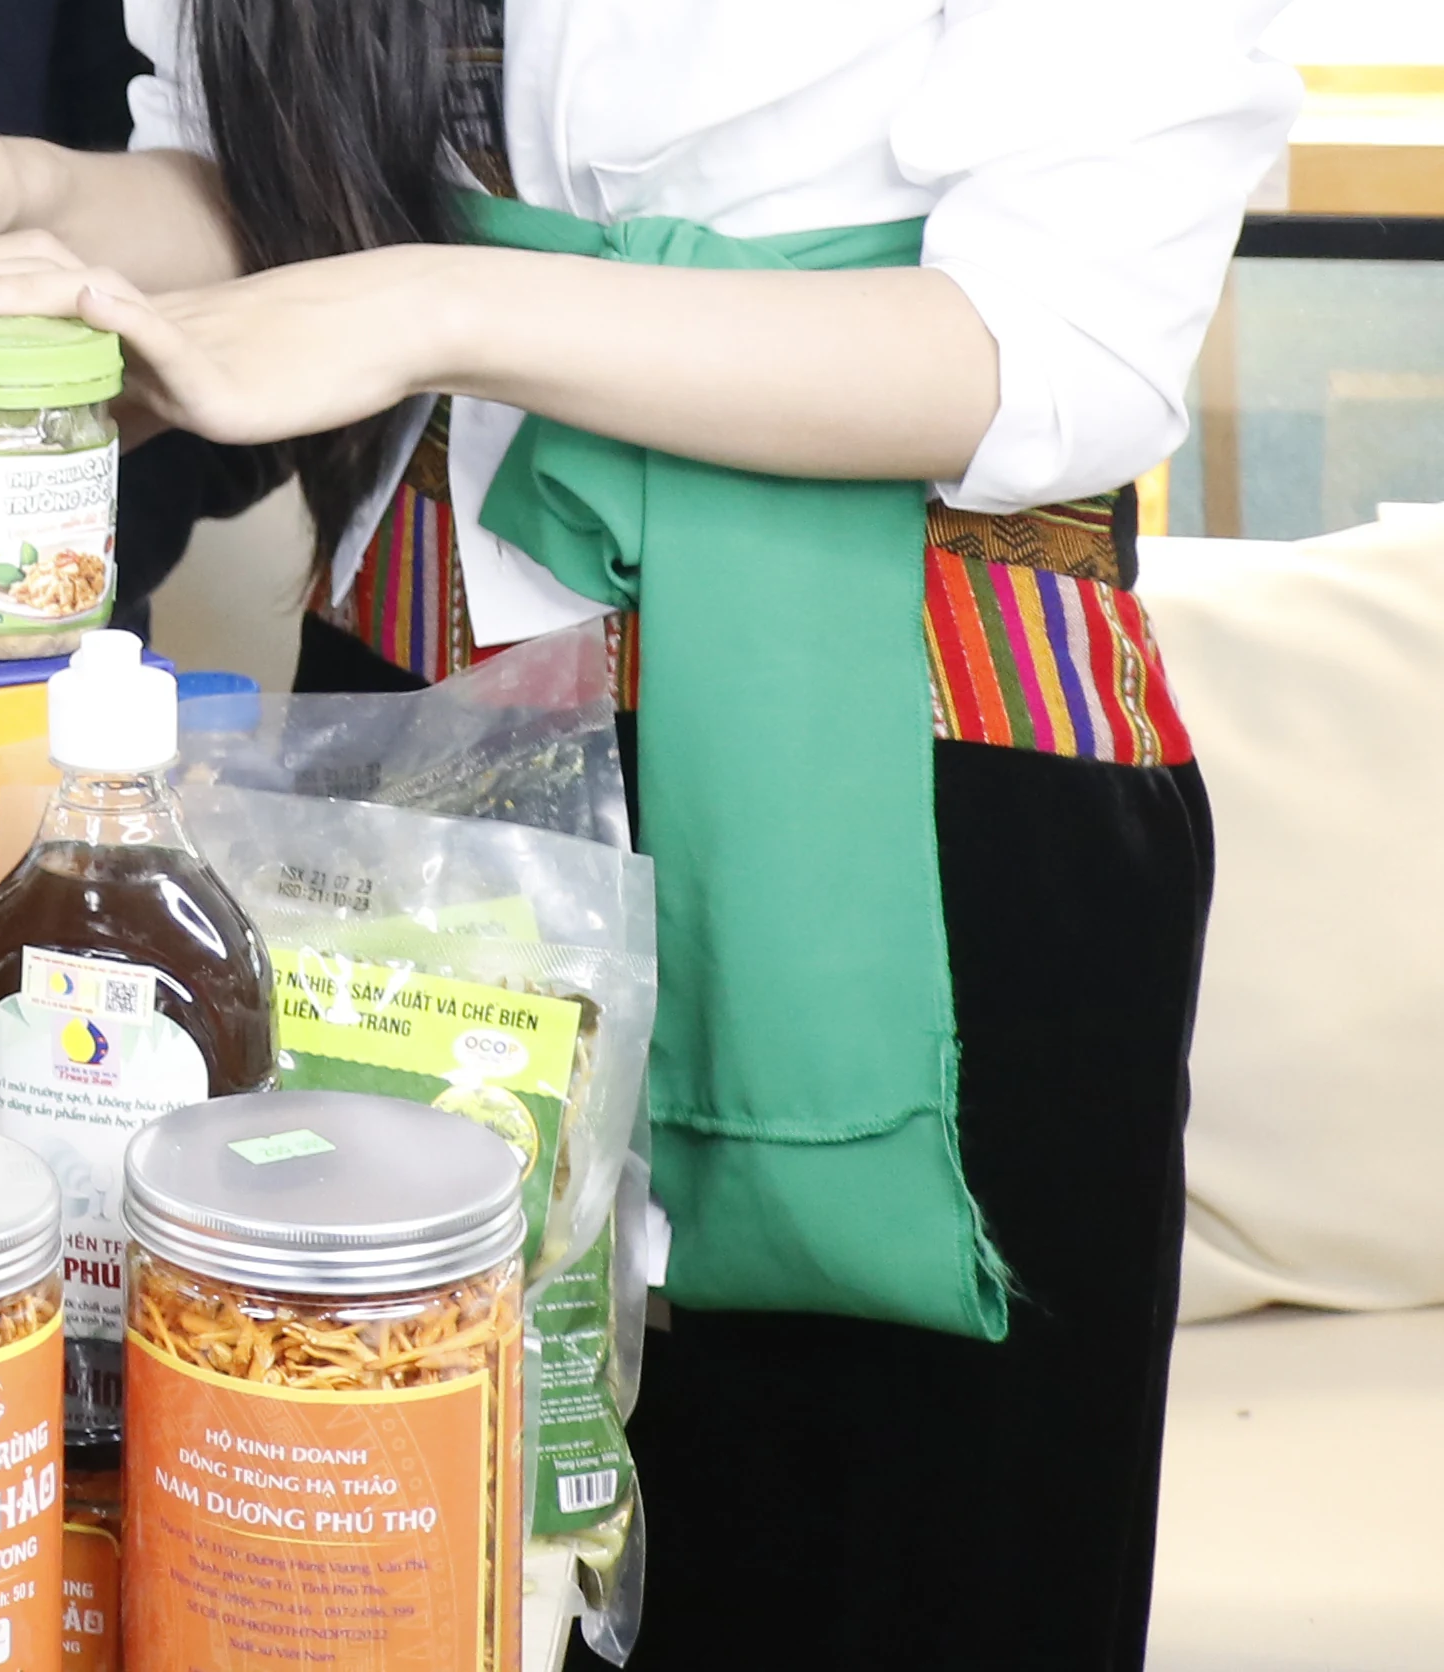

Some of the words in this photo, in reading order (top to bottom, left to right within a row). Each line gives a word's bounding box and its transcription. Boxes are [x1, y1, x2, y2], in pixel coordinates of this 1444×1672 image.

[4, 490, 79, 515] TRƯỜNG
[358, 1011, 413, 1038] TRANG
[389, 989, 434, 1013] XUẤT
[437, 997, 458, 1018] VÀ
[499, 1008, 540, 1033] BIẾN
[464, 1035, 519, 1056] OCOP
[64, 1256, 122, 1290] PHÚ
[205, 1428, 232, 1450] HỘ
[236, 1436, 285, 1461] KINH
[292, 1447, 368, 1465] DOANH
[232, 1465, 300, 1493] TRÙNG
[306, 1478, 336, 1498] HẠ
[341, 1474, 398, 1496] THẢO
[155, 1465, 200, 1506] NAM
[206, 1492, 306, 1531] DƯƠNG
[315, 1506, 374, 1534] PHÚ
[381, 1506, 438, 1534] THỌ
[13, 1582, 26, 1603] 50
